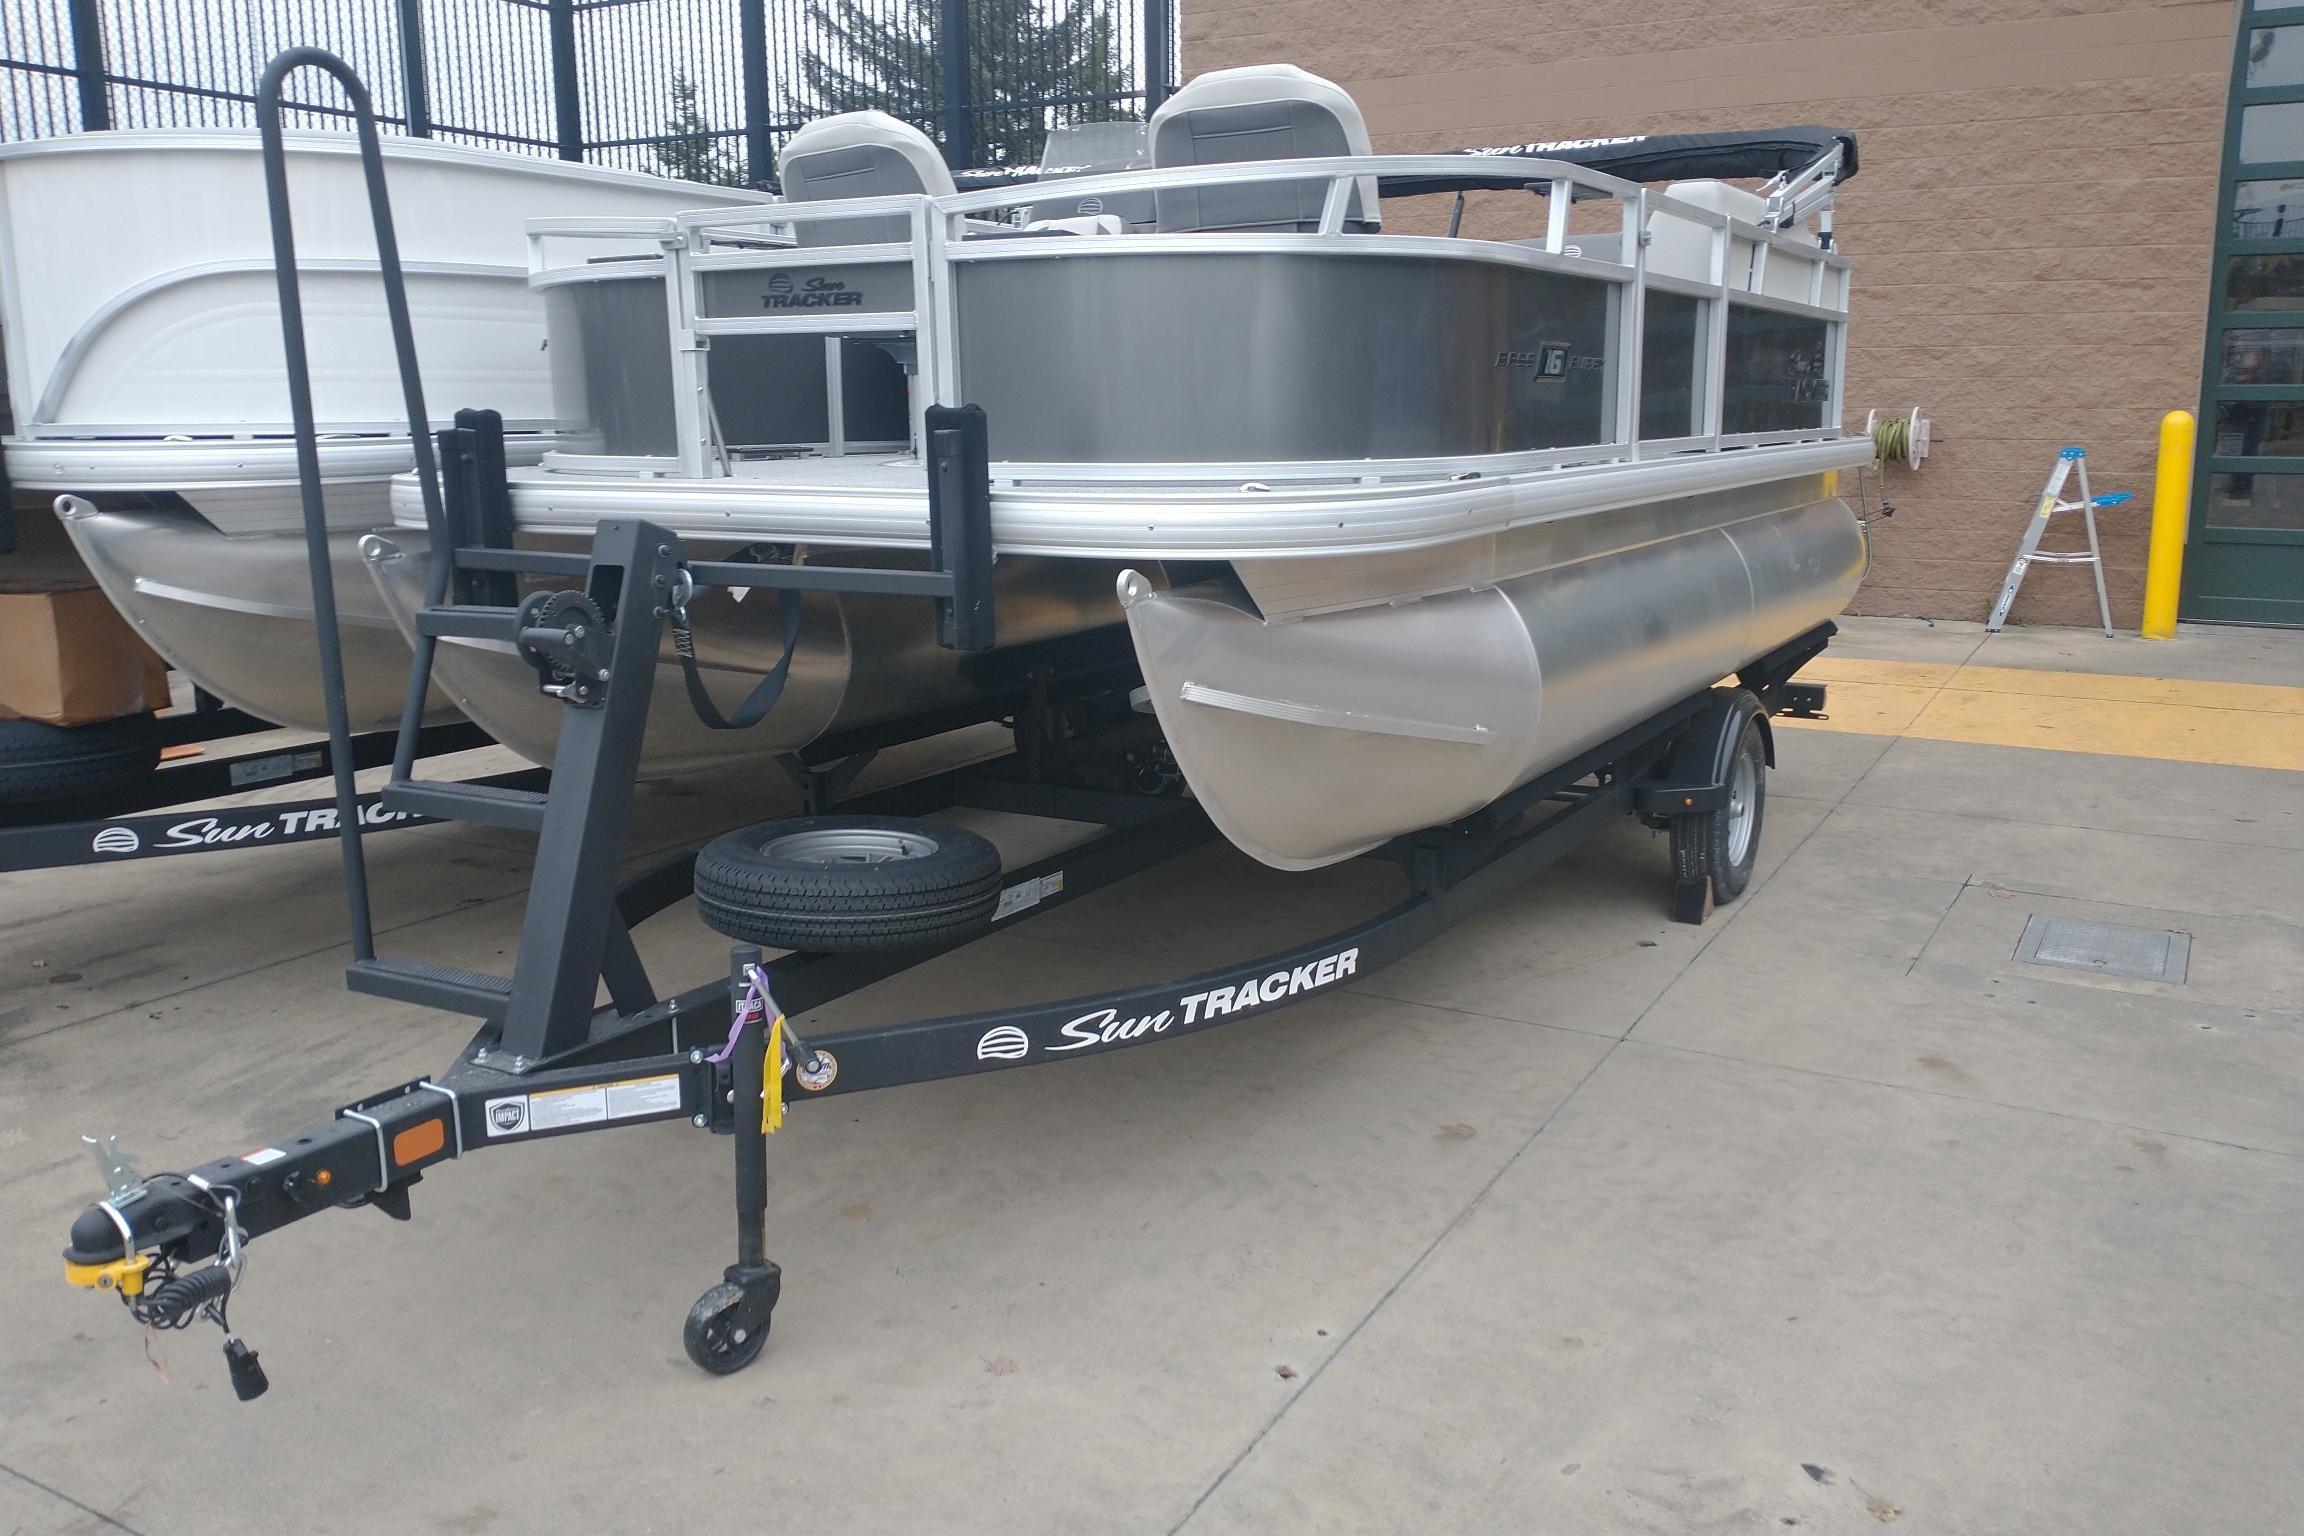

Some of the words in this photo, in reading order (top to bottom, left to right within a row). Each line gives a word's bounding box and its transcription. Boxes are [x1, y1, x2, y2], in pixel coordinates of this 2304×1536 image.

[761, 291, 863, 309] TRACKER
[152, 818, 274, 848] Sun
[1044, 1008, 1175, 1050] Sun
[1179, 948, 1359, 1025] TRACKER
[495, 1109, 520, 1123] IMPACT
